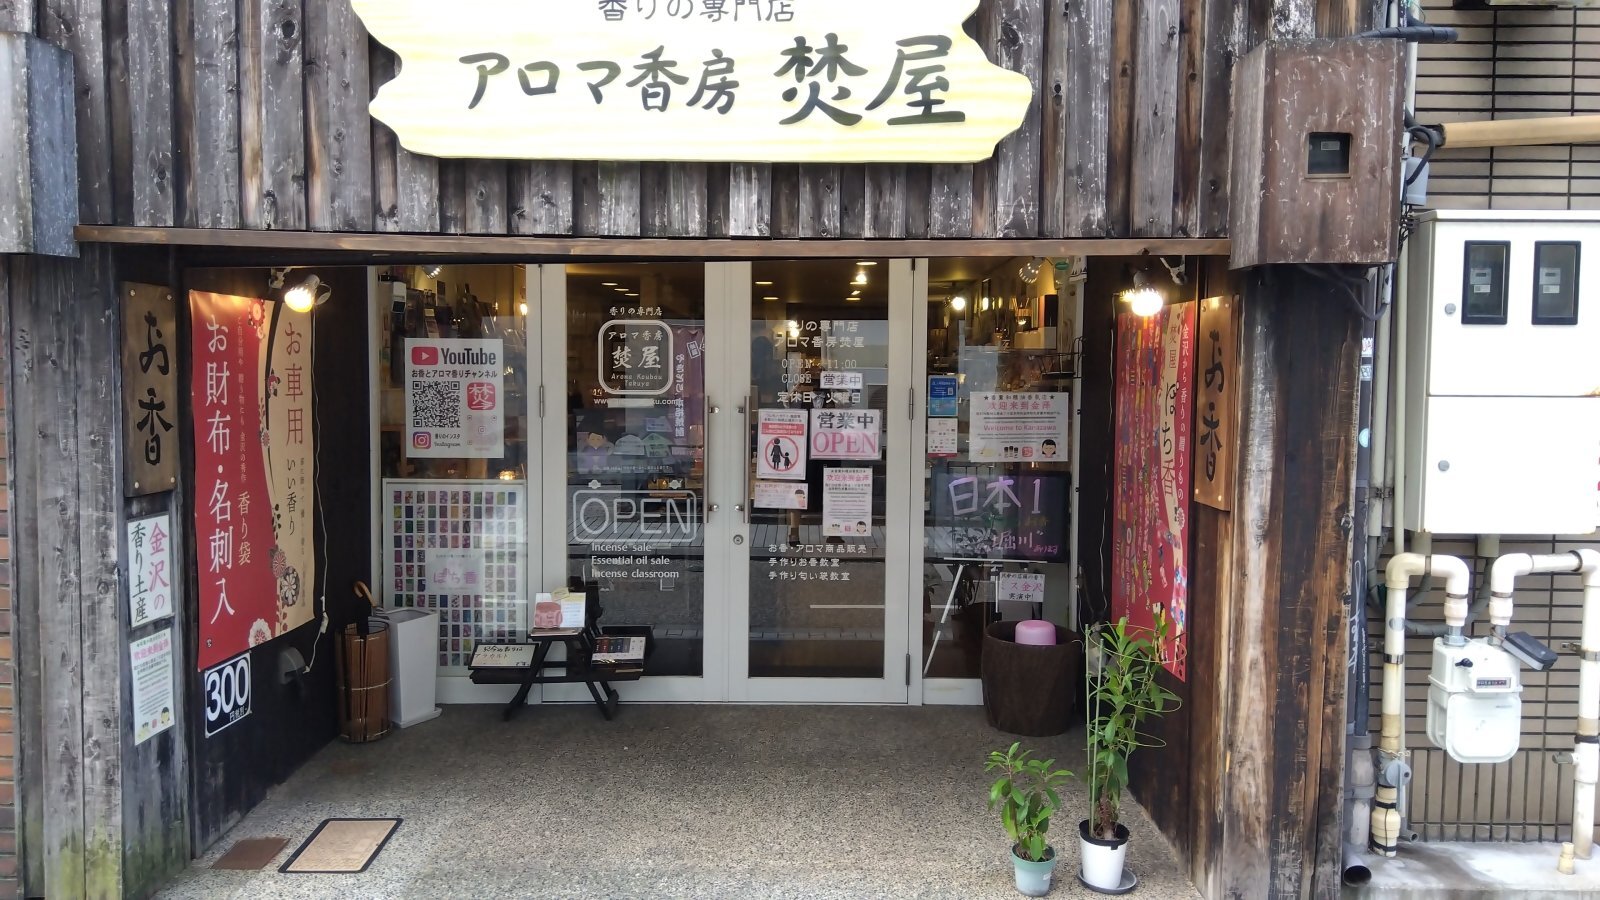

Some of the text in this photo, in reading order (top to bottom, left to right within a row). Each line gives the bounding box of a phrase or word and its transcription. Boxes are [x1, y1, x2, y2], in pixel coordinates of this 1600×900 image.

[459, 33, 966, 127] アロマ香房 焚屋
[609, 306, 663, 317] 香りの専門店
[608, 330, 664, 341] アロマ香房
[441, 347, 496, 365] YouTube
[611, 345, 661, 369] 焚屋
[136, 310, 174, 466] お香
[284, 321, 304, 446] お車用
[781, 374, 812, 383] CLOSE
[823, 373, 861, 387] 営業中
[1200, 329, 1225, 482] お香
[817, 412, 875, 430] 営業中
[812, 431, 879, 454] OPEN
[205, 314, 235, 624] お財布・名刺入
[579, 497, 692, 535] OPEN
[591, 543, 652, 552] Incense sale
[148, 521, 169, 610] 金沢の
[591, 556, 670, 565] Essential oil sale
[768, 557, 840, 567] 手作りお香教室
[131, 522, 149, 623] 香り土産
[591, 569, 680, 578] Incense classroom
[206, 658, 249, 722] 300
